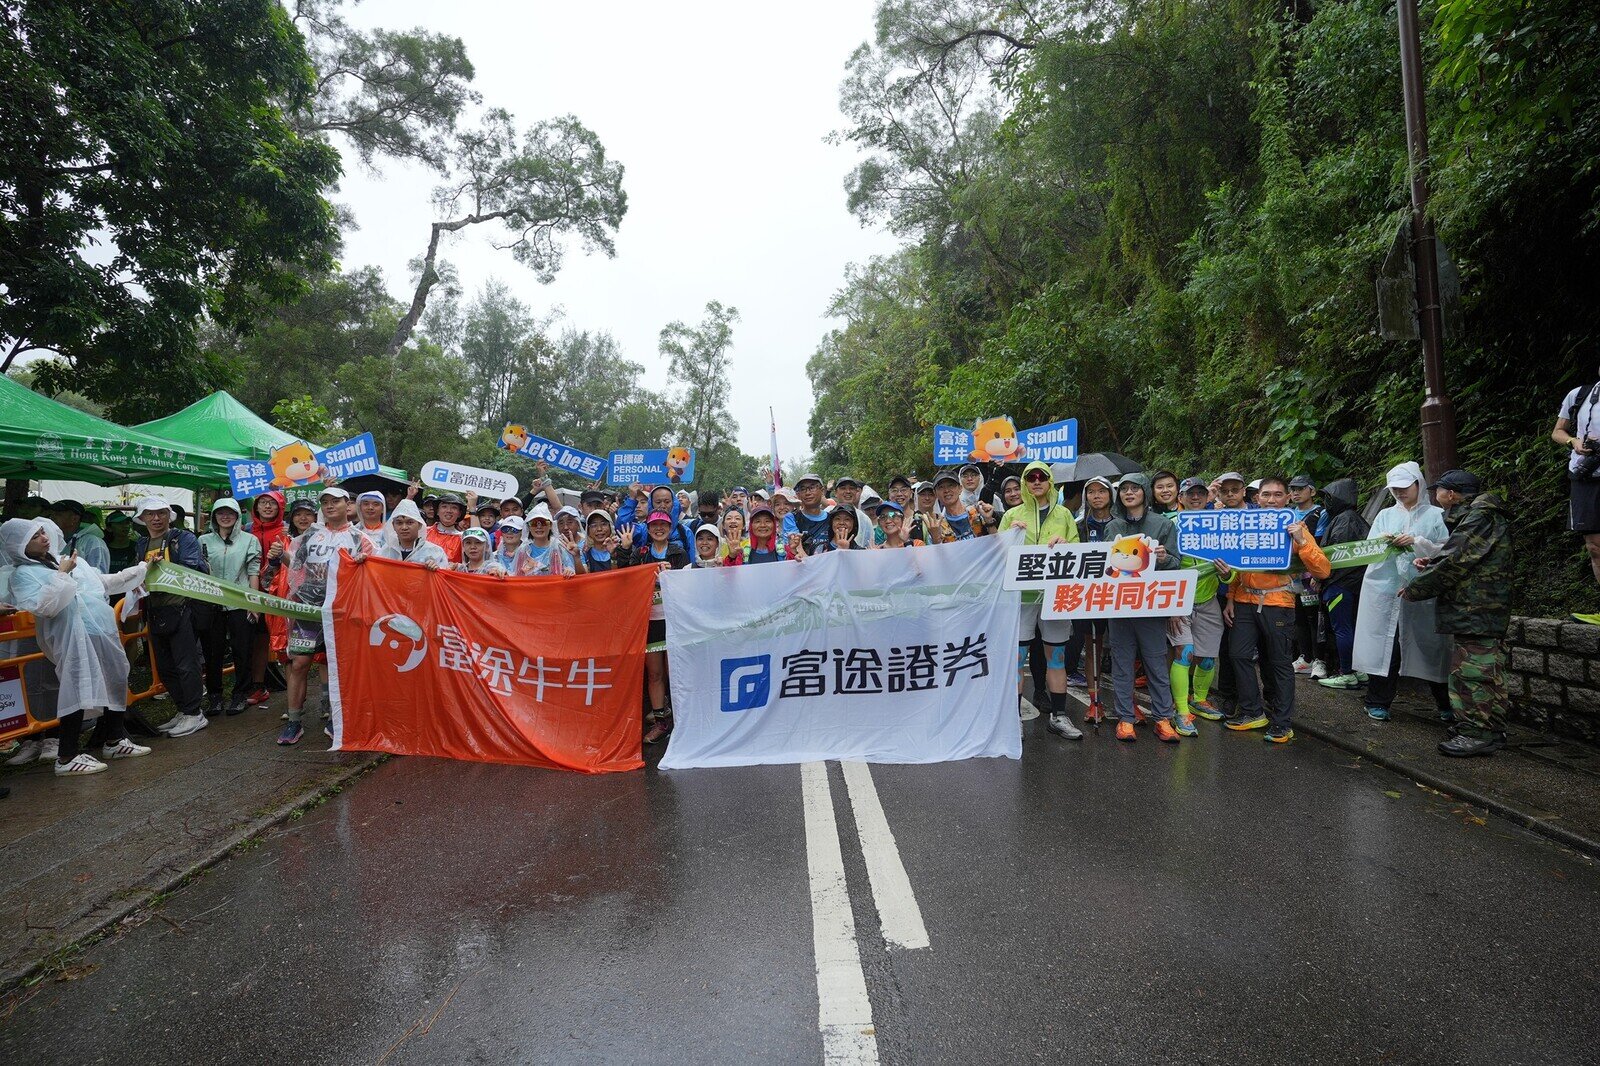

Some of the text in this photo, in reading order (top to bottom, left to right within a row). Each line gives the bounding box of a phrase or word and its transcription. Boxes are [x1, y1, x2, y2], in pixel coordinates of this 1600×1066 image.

[939, 430, 969, 446] 富途
[70, 448, 199, 473] Hong Kong Adventure Corps
[613, 454, 644, 465] 目標破
[938, 446, 968, 461] 牛牛
[1027, 445, 1074, 461] by you
[232, 463, 268, 480] 富途
[329, 456, 376, 479] by you
[613, 465, 662, 474] PERSONAL
[236, 477, 270, 495] 牛牛
[448, 471, 508, 493] 富途證券
[1181, 512, 1292, 531] 不可能任務?
[1181, 533, 1286, 550] 我哋做得到!
[1015, 550, 1107, 581] 堅並肩
[1052, 580, 1187, 612] 夥伴同行!
[436, 623, 613, 706] 富途牛牛
[779, 632, 989, 699] 富途證券
